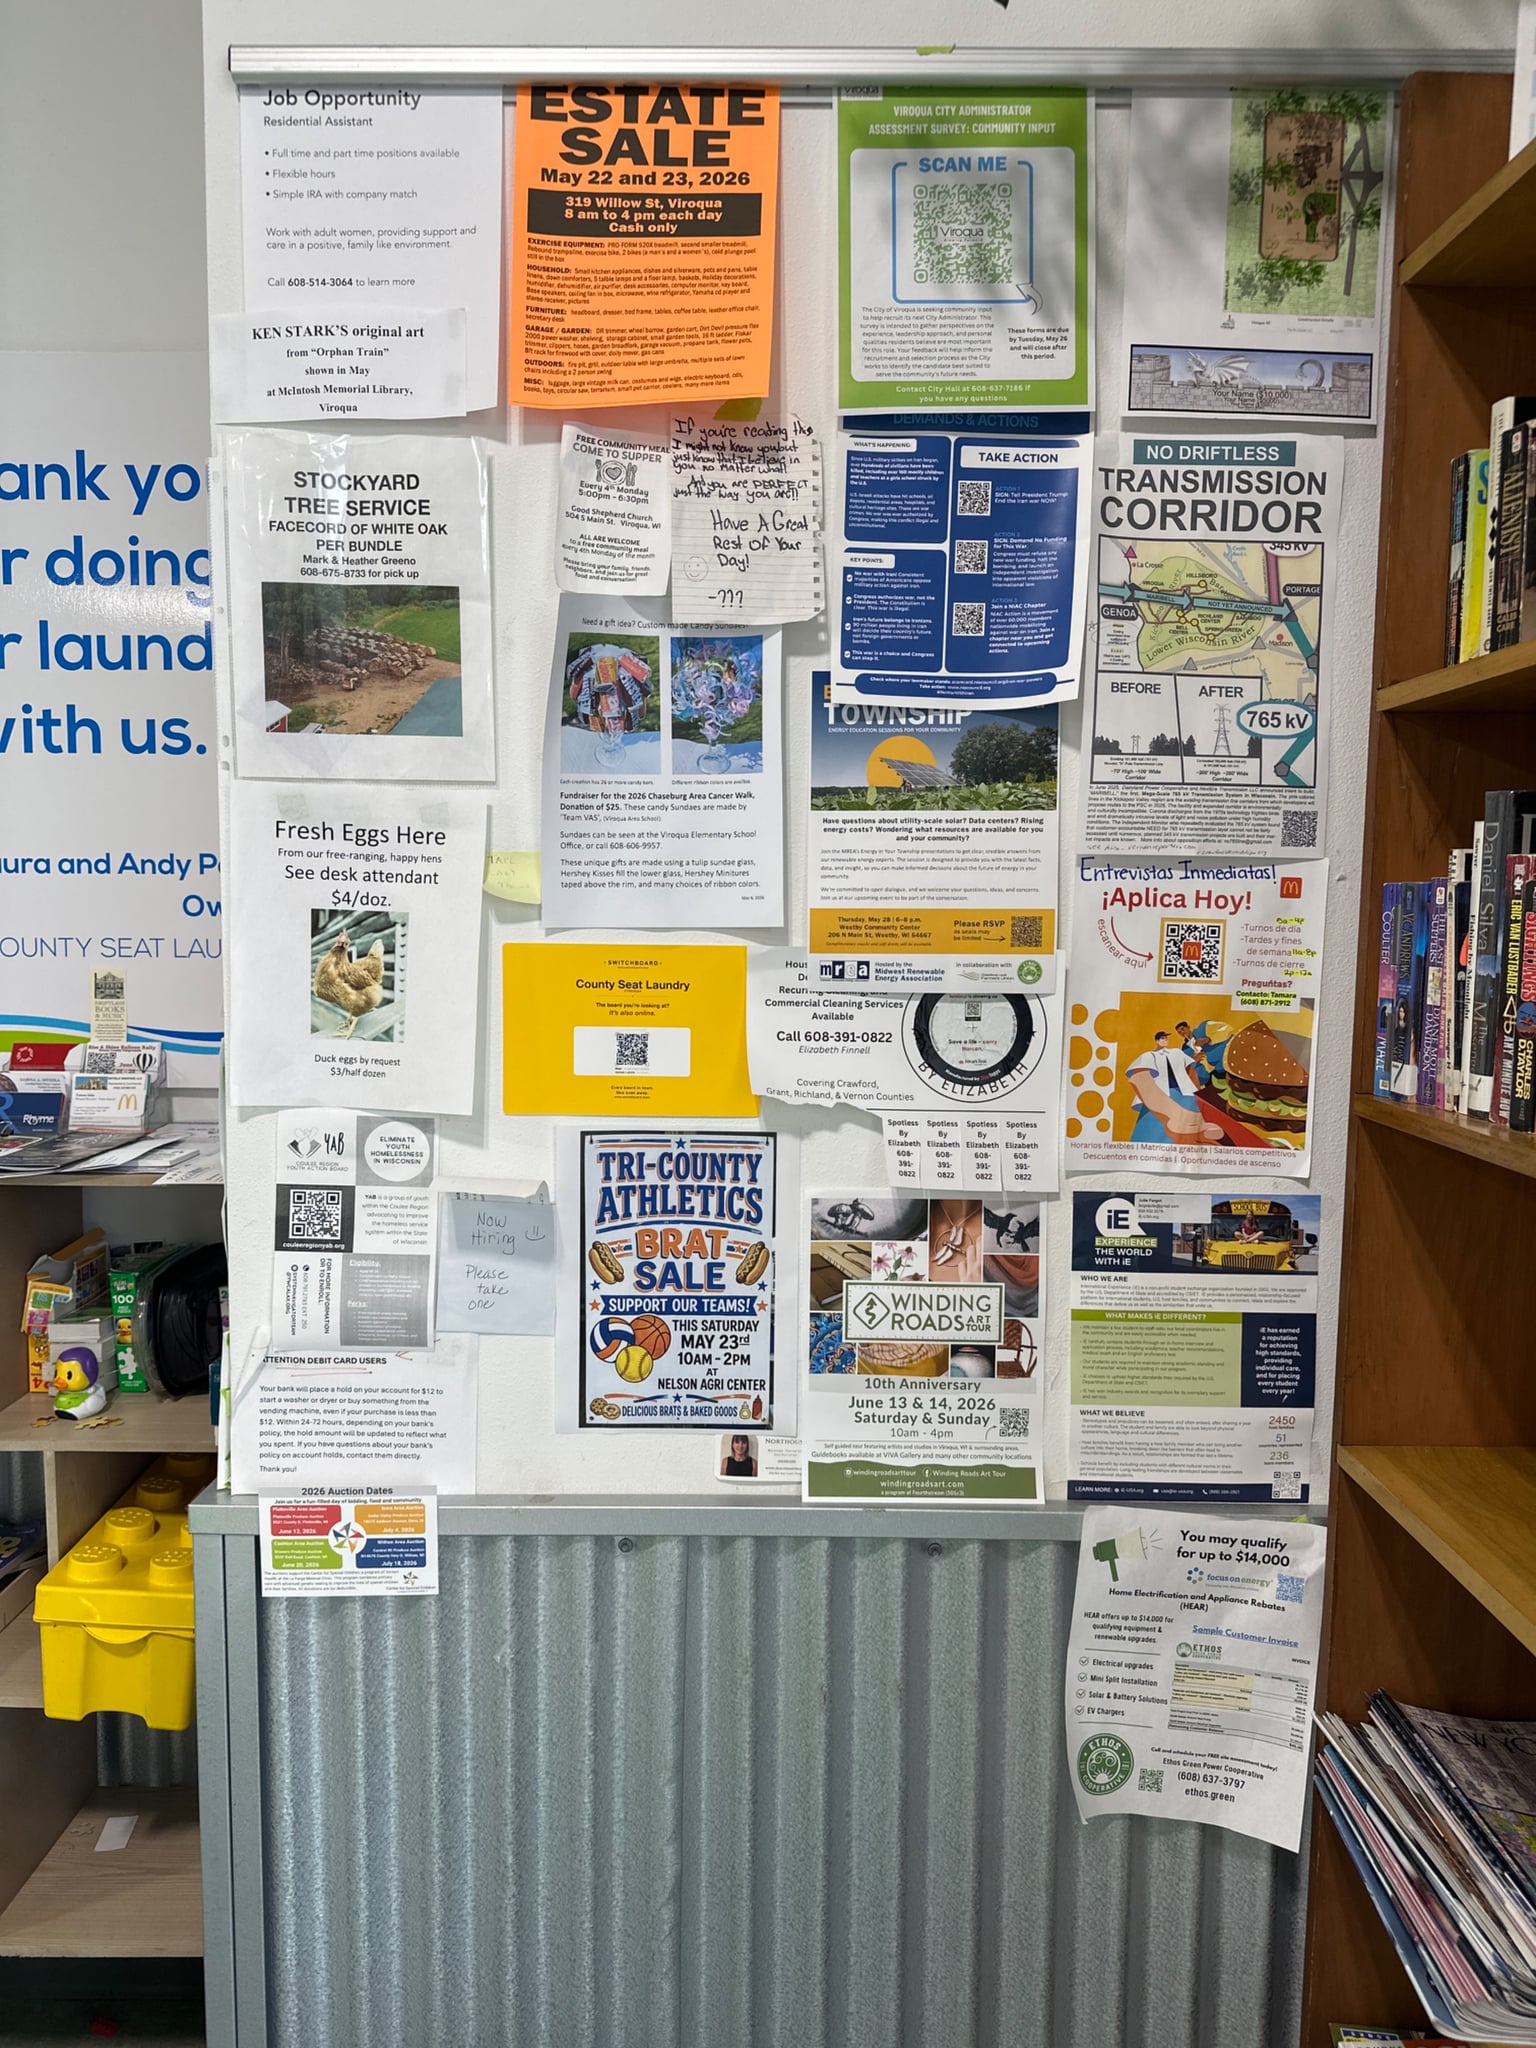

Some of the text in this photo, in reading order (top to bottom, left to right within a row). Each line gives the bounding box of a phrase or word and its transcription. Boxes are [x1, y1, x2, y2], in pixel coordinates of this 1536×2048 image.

[263, 88, 421, 111] Job Opportunity
[529, 86, 766, 126] ESTATE
[893, 104, 1031, 117] VIROQUA CITY ADMINISTRATOR
[559, 127, 730, 167] SALE
[919, 155, 1007, 172] SCAN ME
[541, 168, 750, 188] May 22 and 23, 2026
[565, 196, 722, 211] 319 Willow St, Viroqua
[268, 278, 284, 286] Call
[288, 277, 353, 287] 608-514-3064
[368, 278, 389, 286] learn
[252, 327, 281, 340] KEN
[352, 324, 402, 341] original
[406, 327, 424, 338] art
[573, 442, 662, 463] COME TO SUPPER
[978, 452, 1058, 463] TAKE ACTION
[1146, 446, 1280, 462] NO DRIFTLESS
[294, 471, 420, 491] STOCKYARD
[1098, 467, 1327, 496] TRANSMISSION
[284, 497, 430, 516] TREE SERVICE
[1500, 470, 1524, 555] ALIENIST
[710, 509, 809, 533] Have A Great
[1100, 497, 1323, 534] CORRIDOR
[713, 535, 743, 550] Rest
[775, 537, 802, 551] Your
[716, 553, 749, 572] Day!
[300, 567, 419, 580] 608-675-8733 for pick up
[1102, 606, 1137, 618] GENOA
[1110, 682, 1162, 695] BEFORE
[1199, 685, 1244, 699] AFTER
[824, 702, 972, 724] TOWNSHIP
[1247, 711, 1309, 730] 765 kV
[121, 718, 206, 755] us.
[276, 820, 446, 848] Fresh Eggs Here
[560, 841, 584, 850] Office,
[596, 841, 608, 849] call
[58, 853, 191, 881] and Andy
[285, 865, 438, 885] See desk attendant
[1080, 857, 1278, 885] Entrevistas Inmediatas!
[1477, 821, 1500, 950] Daniel Silva
[331, 889, 391, 907] $4/doz.
[1102, 887, 1252, 915] ¡Aplica Hoy!
[953, 919, 1005, 928] Please RSVP
[1506, 899, 1522, 995] ERIC VAN LUSTBADER
[874, 974, 943, 983] Energy Association
[875, 967, 945, 976] Midwest Renewable
[576, 979, 690, 992] County Seat Laundry
[776, 1031, 893, 1043] Call 608-391-0822
[314, 1054, 400, 1067] Duck eggs by request
[23, 1113, 55, 1124] Rhyme
[324, 1132, 346, 1156] YAB
[379, 1136, 416, 1144] ELIMINATE
[386, 1143, 411, 1151] YOUTH
[370, 1150, 425, 1159] HOMELESSNESS
[597, 1151, 763, 1183] TRI-COUNTY
[595, 1183, 764, 1226] ATHLETICS
[477, 1213, 508, 1229] Now
[471, 1231, 516, 1255] Hiring
[635, 1227, 729, 1260] BRAT
[1095, 1237, 1157, 1247] EXPERIENCE
[1095, 1247, 1153, 1257] THE WORLD
[466, 1264, 509, 1280] Please
[634, 1261, 727, 1292] SALE
[477, 1283, 510, 1296] take
[112, 1294, 134, 1304] 100
[467, 1299, 496, 1311] one
[609, 1299, 751, 1313] SUPPORT OUR TEAMS!
[891, 1293, 992, 1312] WINDING
[891, 1313, 965, 1332] ROADS
[680, 1335, 715, 1350] MAY
[307, 1356, 387, 1365] DEBIT CARD USERS
[658, 1378, 767, 1391] NELSON AGRI CENTER
[864, 1377, 982, 1393] 10th Anniversary
[848, 1396, 996, 1412] June 13 & 14, 2026
[1268, 1415, 1296, 1425] 2450
[1269, 1451, 1289, 1461] 236
[300, 1486, 394, 1497] 2026 Auction Dates
[880, 1479, 965, 1489] windingroadsart.com
[1180, 1530, 1288, 1553] You may qualify
[1177, 1546, 1291, 1568] for up to $14,000
[1177, 1772, 1246, 1790] (608) 637-3797
[1184, 1787, 1236, 1804] ethos.green
